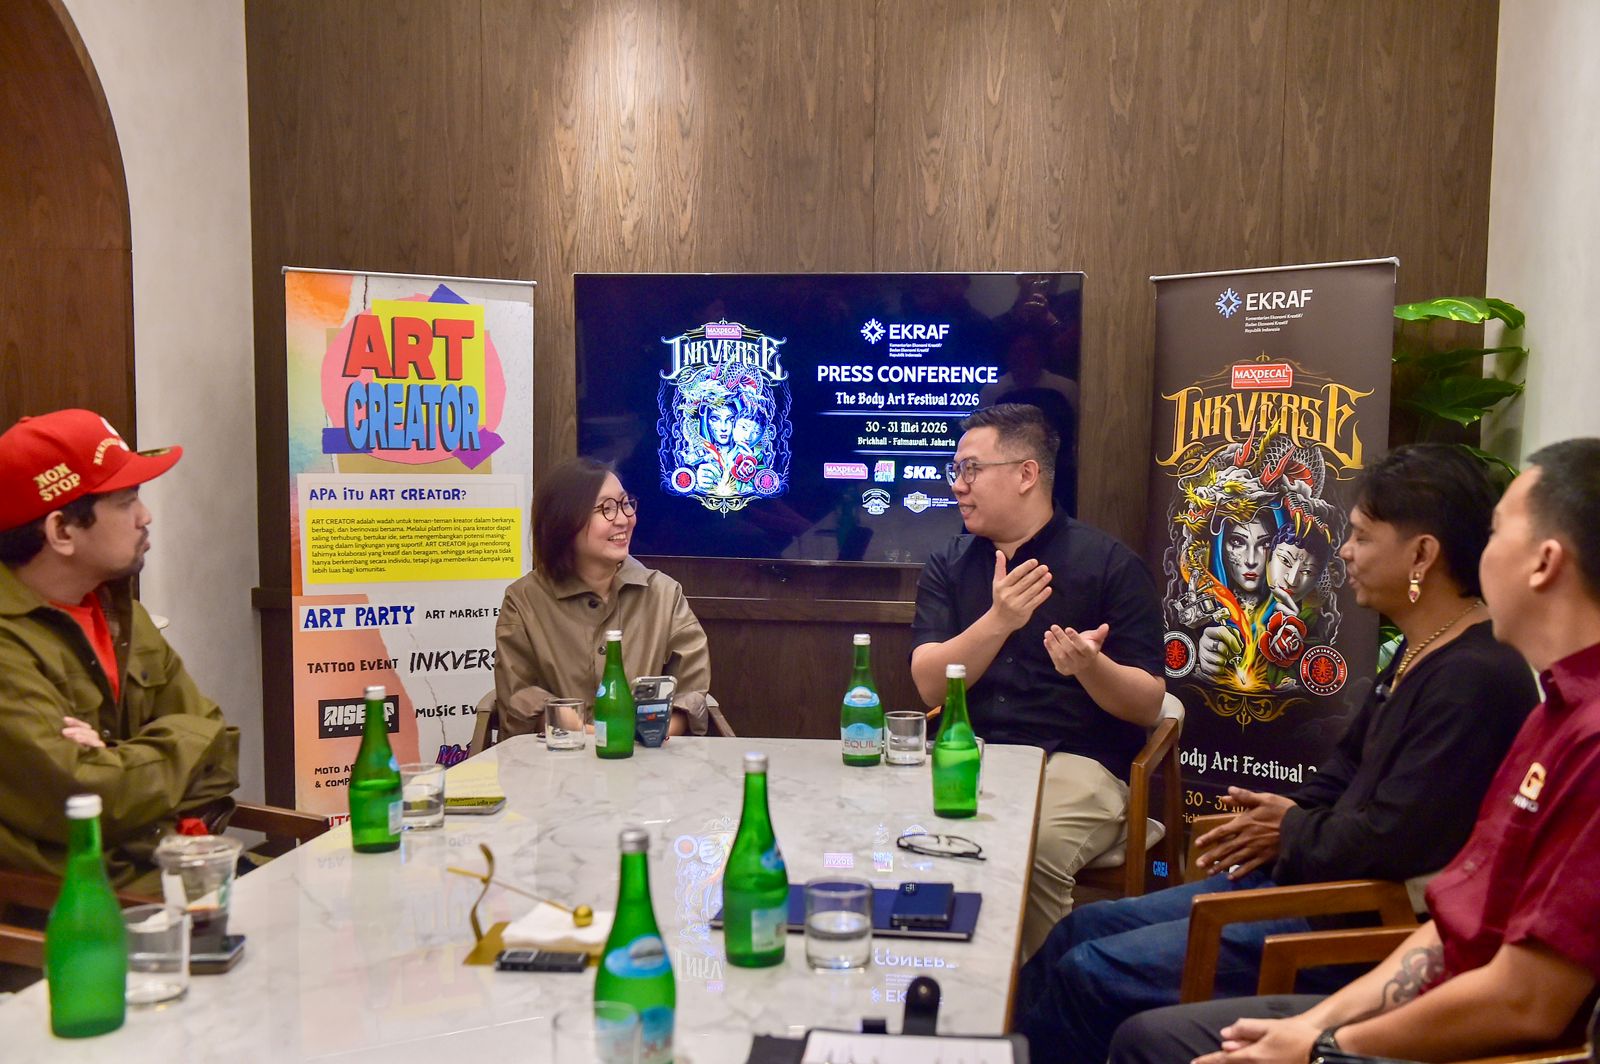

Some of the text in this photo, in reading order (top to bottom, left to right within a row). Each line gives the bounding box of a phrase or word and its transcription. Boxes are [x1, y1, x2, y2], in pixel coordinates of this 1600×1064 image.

[1246, 289, 1313, 311] EKRAF
[889, 324, 950, 340] EKRAF
[342, 314, 475, 381] ART
[659, 336, 789, 381] INKVERSE
[817, 366, 999, 384] PRESS CONFERENCE
[1234, 368, 1288, 384] MAXDECAL
[835, 392, 980, 409] The Body Art Festival 2026
[344, 380, 480, 452] CREATOR
[865, 421, 880, 433] 30
[888, 421, 899, 433] 31
[900, 421, 919, 433] Mei
[921, 422, 948, 434] 2026
[1155, 383, 1375, 470] INKVERSE
[857, 436, 888, 446] Brickhall
[929, 438, 956, 447] Jakarta
[33, 462, 72, 489] NON
[826, 466, 866, 476] MAXDECAL
[903, 465, 942, 480] SKR.
[38, 473, 81, 502] STOP
[309, 488, 337, 501] APA
[369, 488, 396, 501] ART
[401, 488, 467, 501] CREATOR?
[496, 524, 512, 532] dapat
[414, 533, 463, 541] mengembangkan
[354, 542, 386, 550] lingkungan
[303, 606, 416, 629] ART PARTY
[425, 610, 446, 619] ART
[449, 608, 489, 619] MARKET
[307, 658, 399, 674] TATTOO EVENT
[323, 704, 367, 726] RISE
[844, 740, 877, 749] EQUIL
[314, 766, 340, 775] MOTO
[1179, 748, 1303, 784] ody Art Festival
[315, 780, 321, 788] &
[1185, 790, 1204, 807] 30
